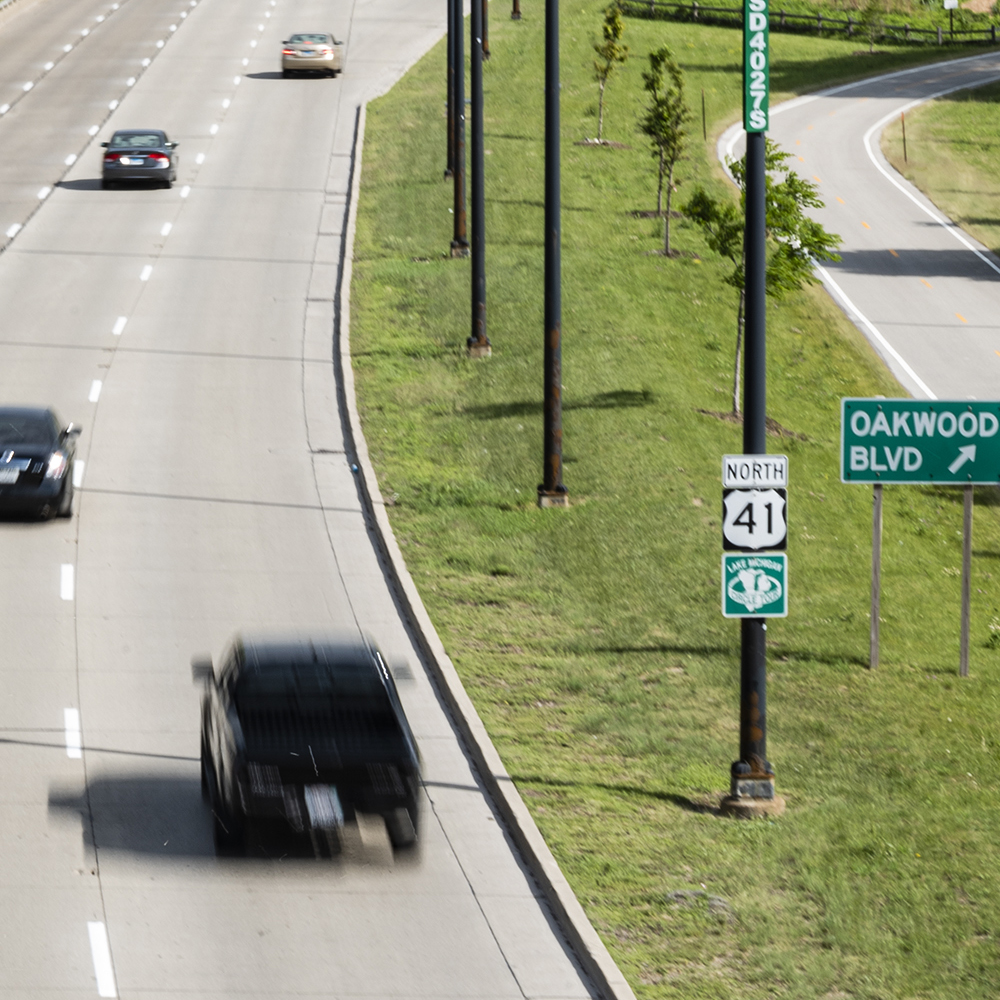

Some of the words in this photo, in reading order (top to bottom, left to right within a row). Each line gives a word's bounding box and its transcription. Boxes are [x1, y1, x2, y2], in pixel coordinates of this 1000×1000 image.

[850, 410, 999, 438] OAKWOOD
[727, 463, 784, 480] NORTH
[850, 445, 923, 472] BLVD
[732, 502, 773, 534] 41
[726, 559, 747, 574] LAKE
[747, 557, 783, 573] MICHIGAN
